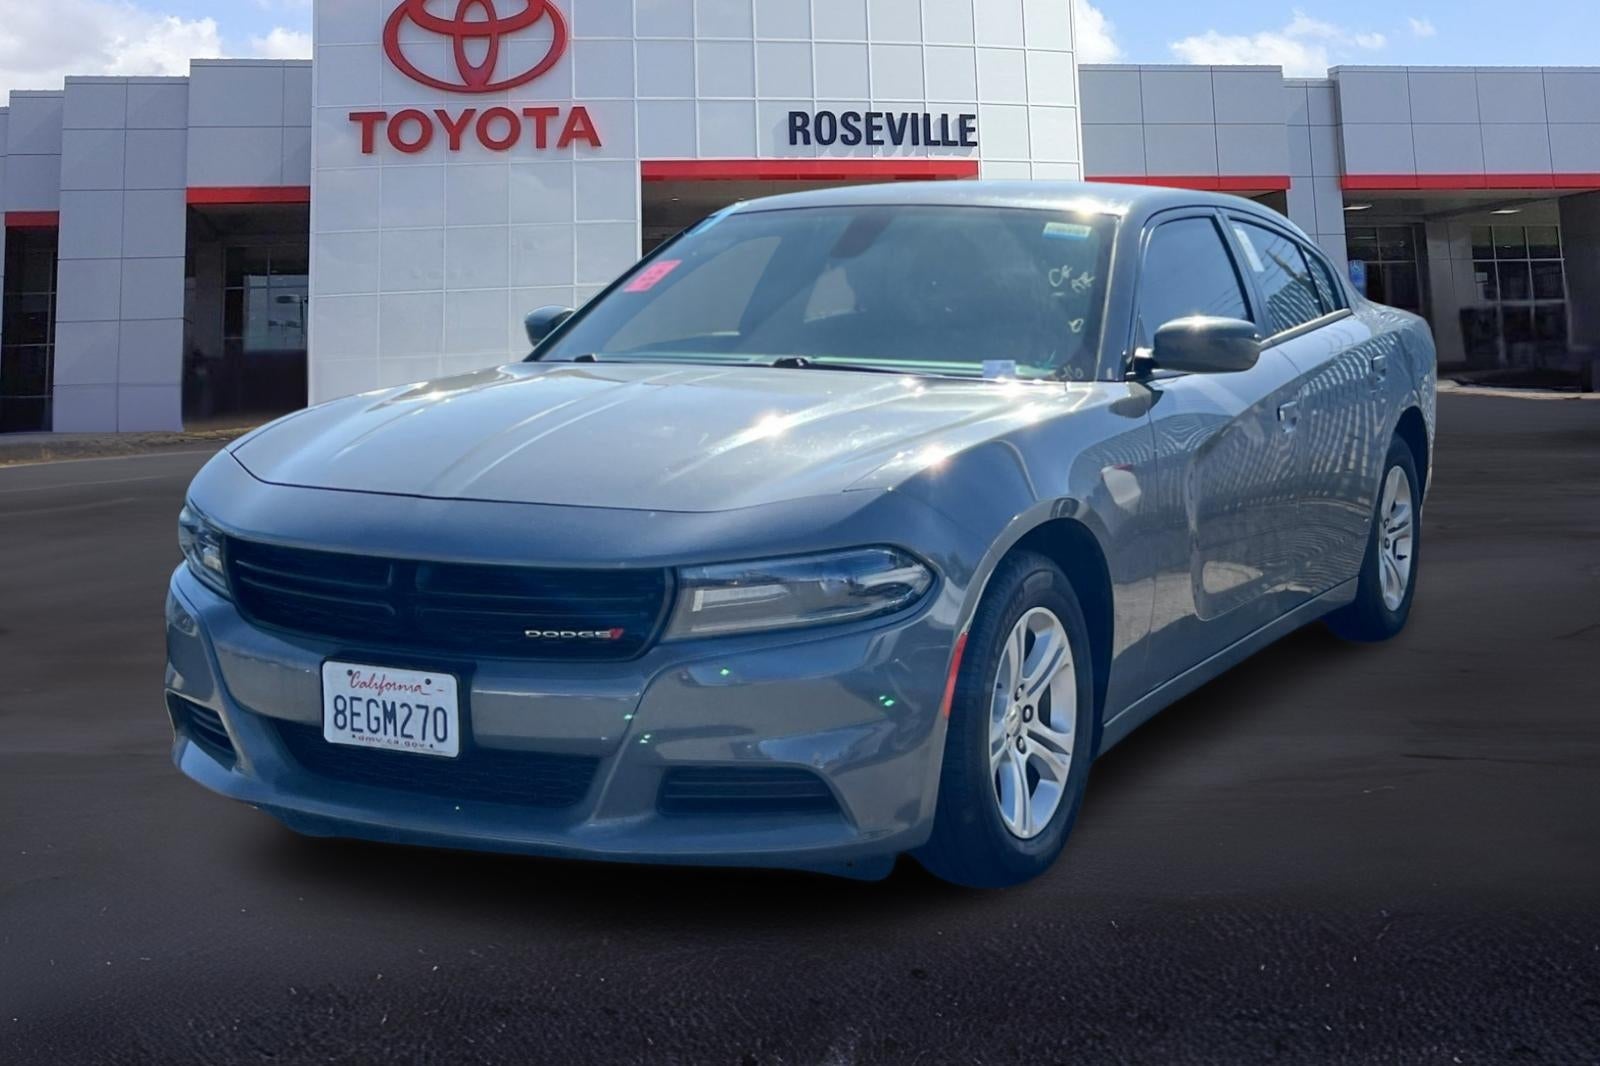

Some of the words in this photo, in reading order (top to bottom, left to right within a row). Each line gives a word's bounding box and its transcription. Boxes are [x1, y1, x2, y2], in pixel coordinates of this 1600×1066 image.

[349, 106, 602, 154] TOYOTA
[788, 111, 978, 147] ROSEVILLE
[525, 630, 611, 638] DODGE
[350, 671, 432, 696] California
[333, 694, 448, 743] 8EGM270
